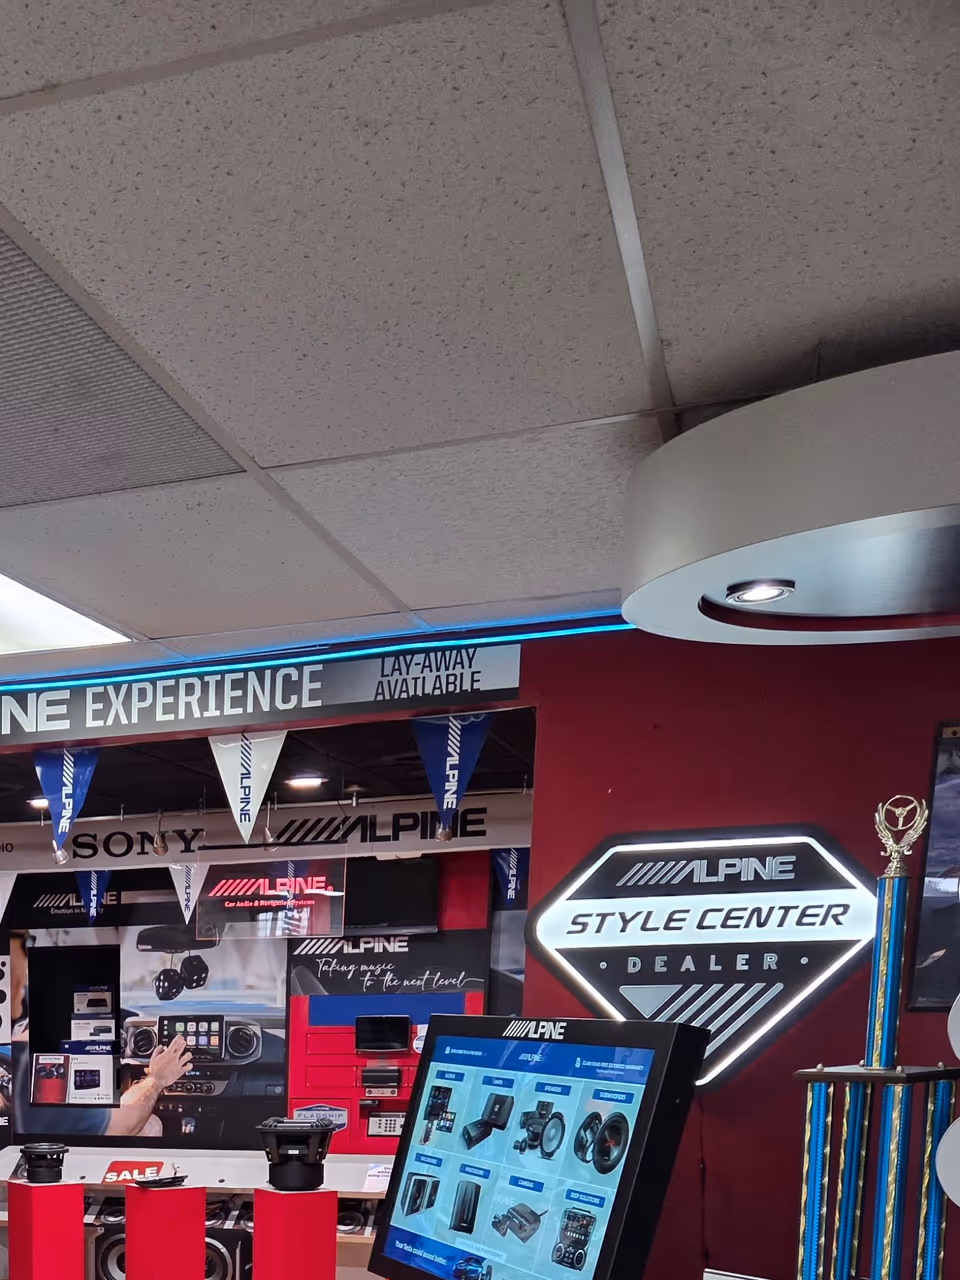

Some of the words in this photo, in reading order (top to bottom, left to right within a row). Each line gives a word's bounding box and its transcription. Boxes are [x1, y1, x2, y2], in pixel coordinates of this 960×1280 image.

[380, 648, 478, 678] LAY-AWAY
[85, 664, 324, 728] EXPERIENCE
[374, 671, 481, 701] AVAILABLE
[240, 767, 252, 823] ALPINE
[442, 753, 459, 810] ALPINE
[58, 778, 74, 834] ALPINE
[338, 807, 487, 843] ALPINE
[72, 828, 205, 860] SONY
[667, 855, 797, 884] ALPINE
[566, 909, 692, 935] STYLE
[696, 903, 851, 930] CENTER
[330, 936, 409, 954] ALPINE
[316, 958, 358, 979] Taking
[360, 962, 395, 975] music
[627, 953, 778, 973] DEALER
[403, 971, 433, 991] next
[433, 971, 484, 989] level
[521, 1021, 567, 1040] ALPINE
[104, 1167, 159, 1183] SALE
